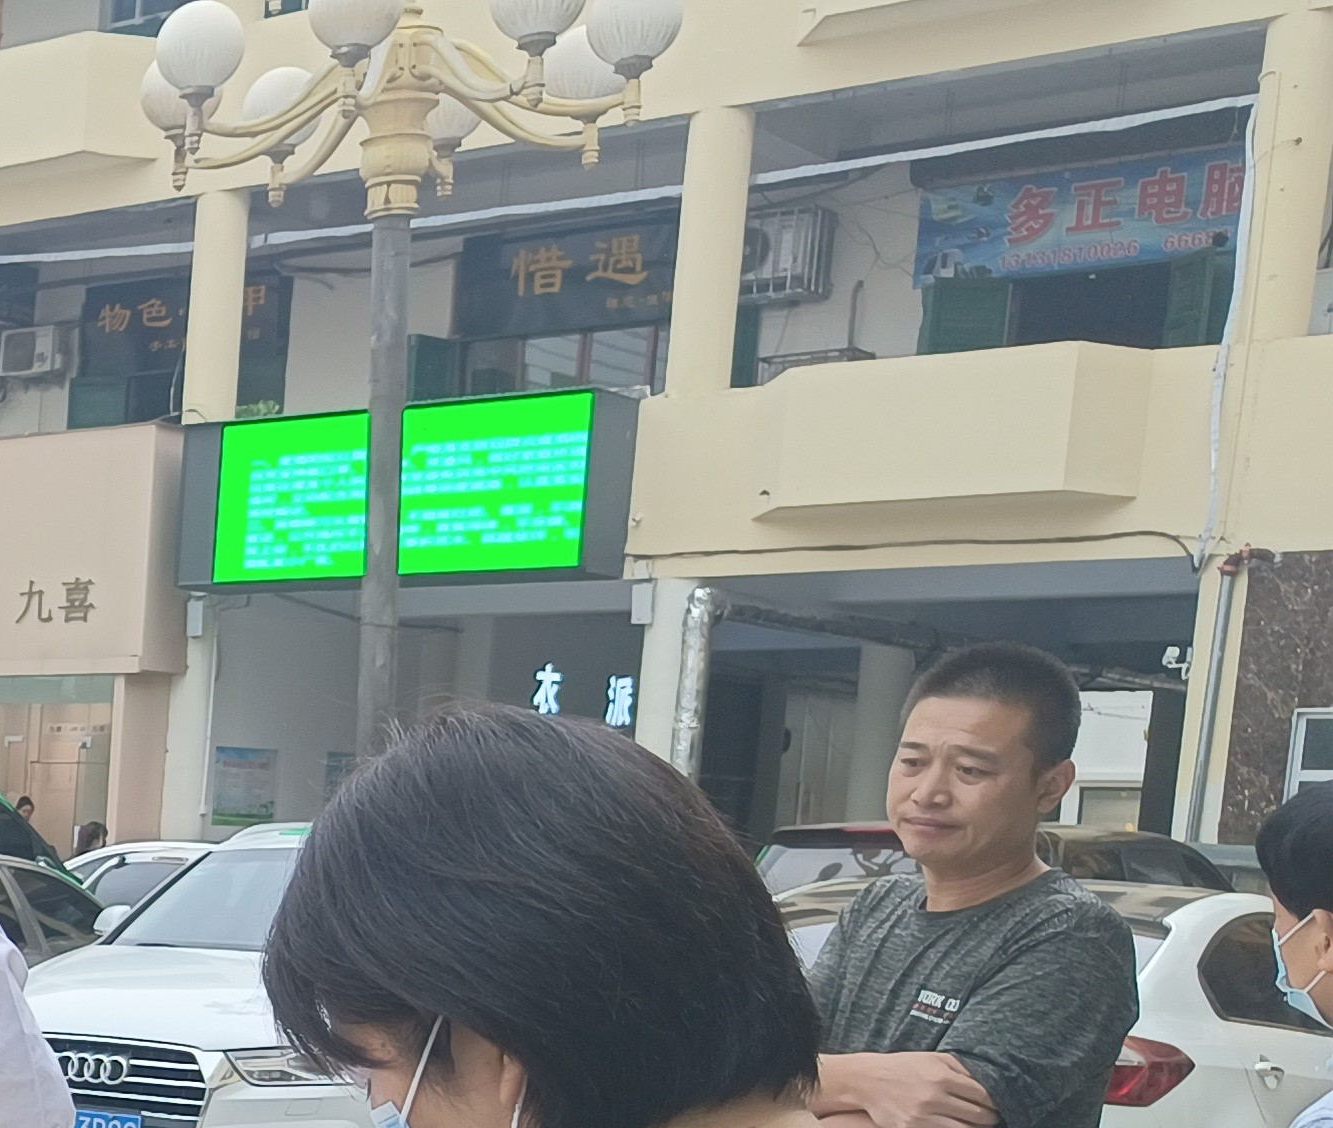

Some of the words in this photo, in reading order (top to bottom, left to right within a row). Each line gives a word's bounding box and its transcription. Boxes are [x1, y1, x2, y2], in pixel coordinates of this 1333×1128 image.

[1005, 160, 1245, 247] 多正电脑
[510, 234, 648, 296] 惜遇
[15, 576, 97, 624] 九喜
